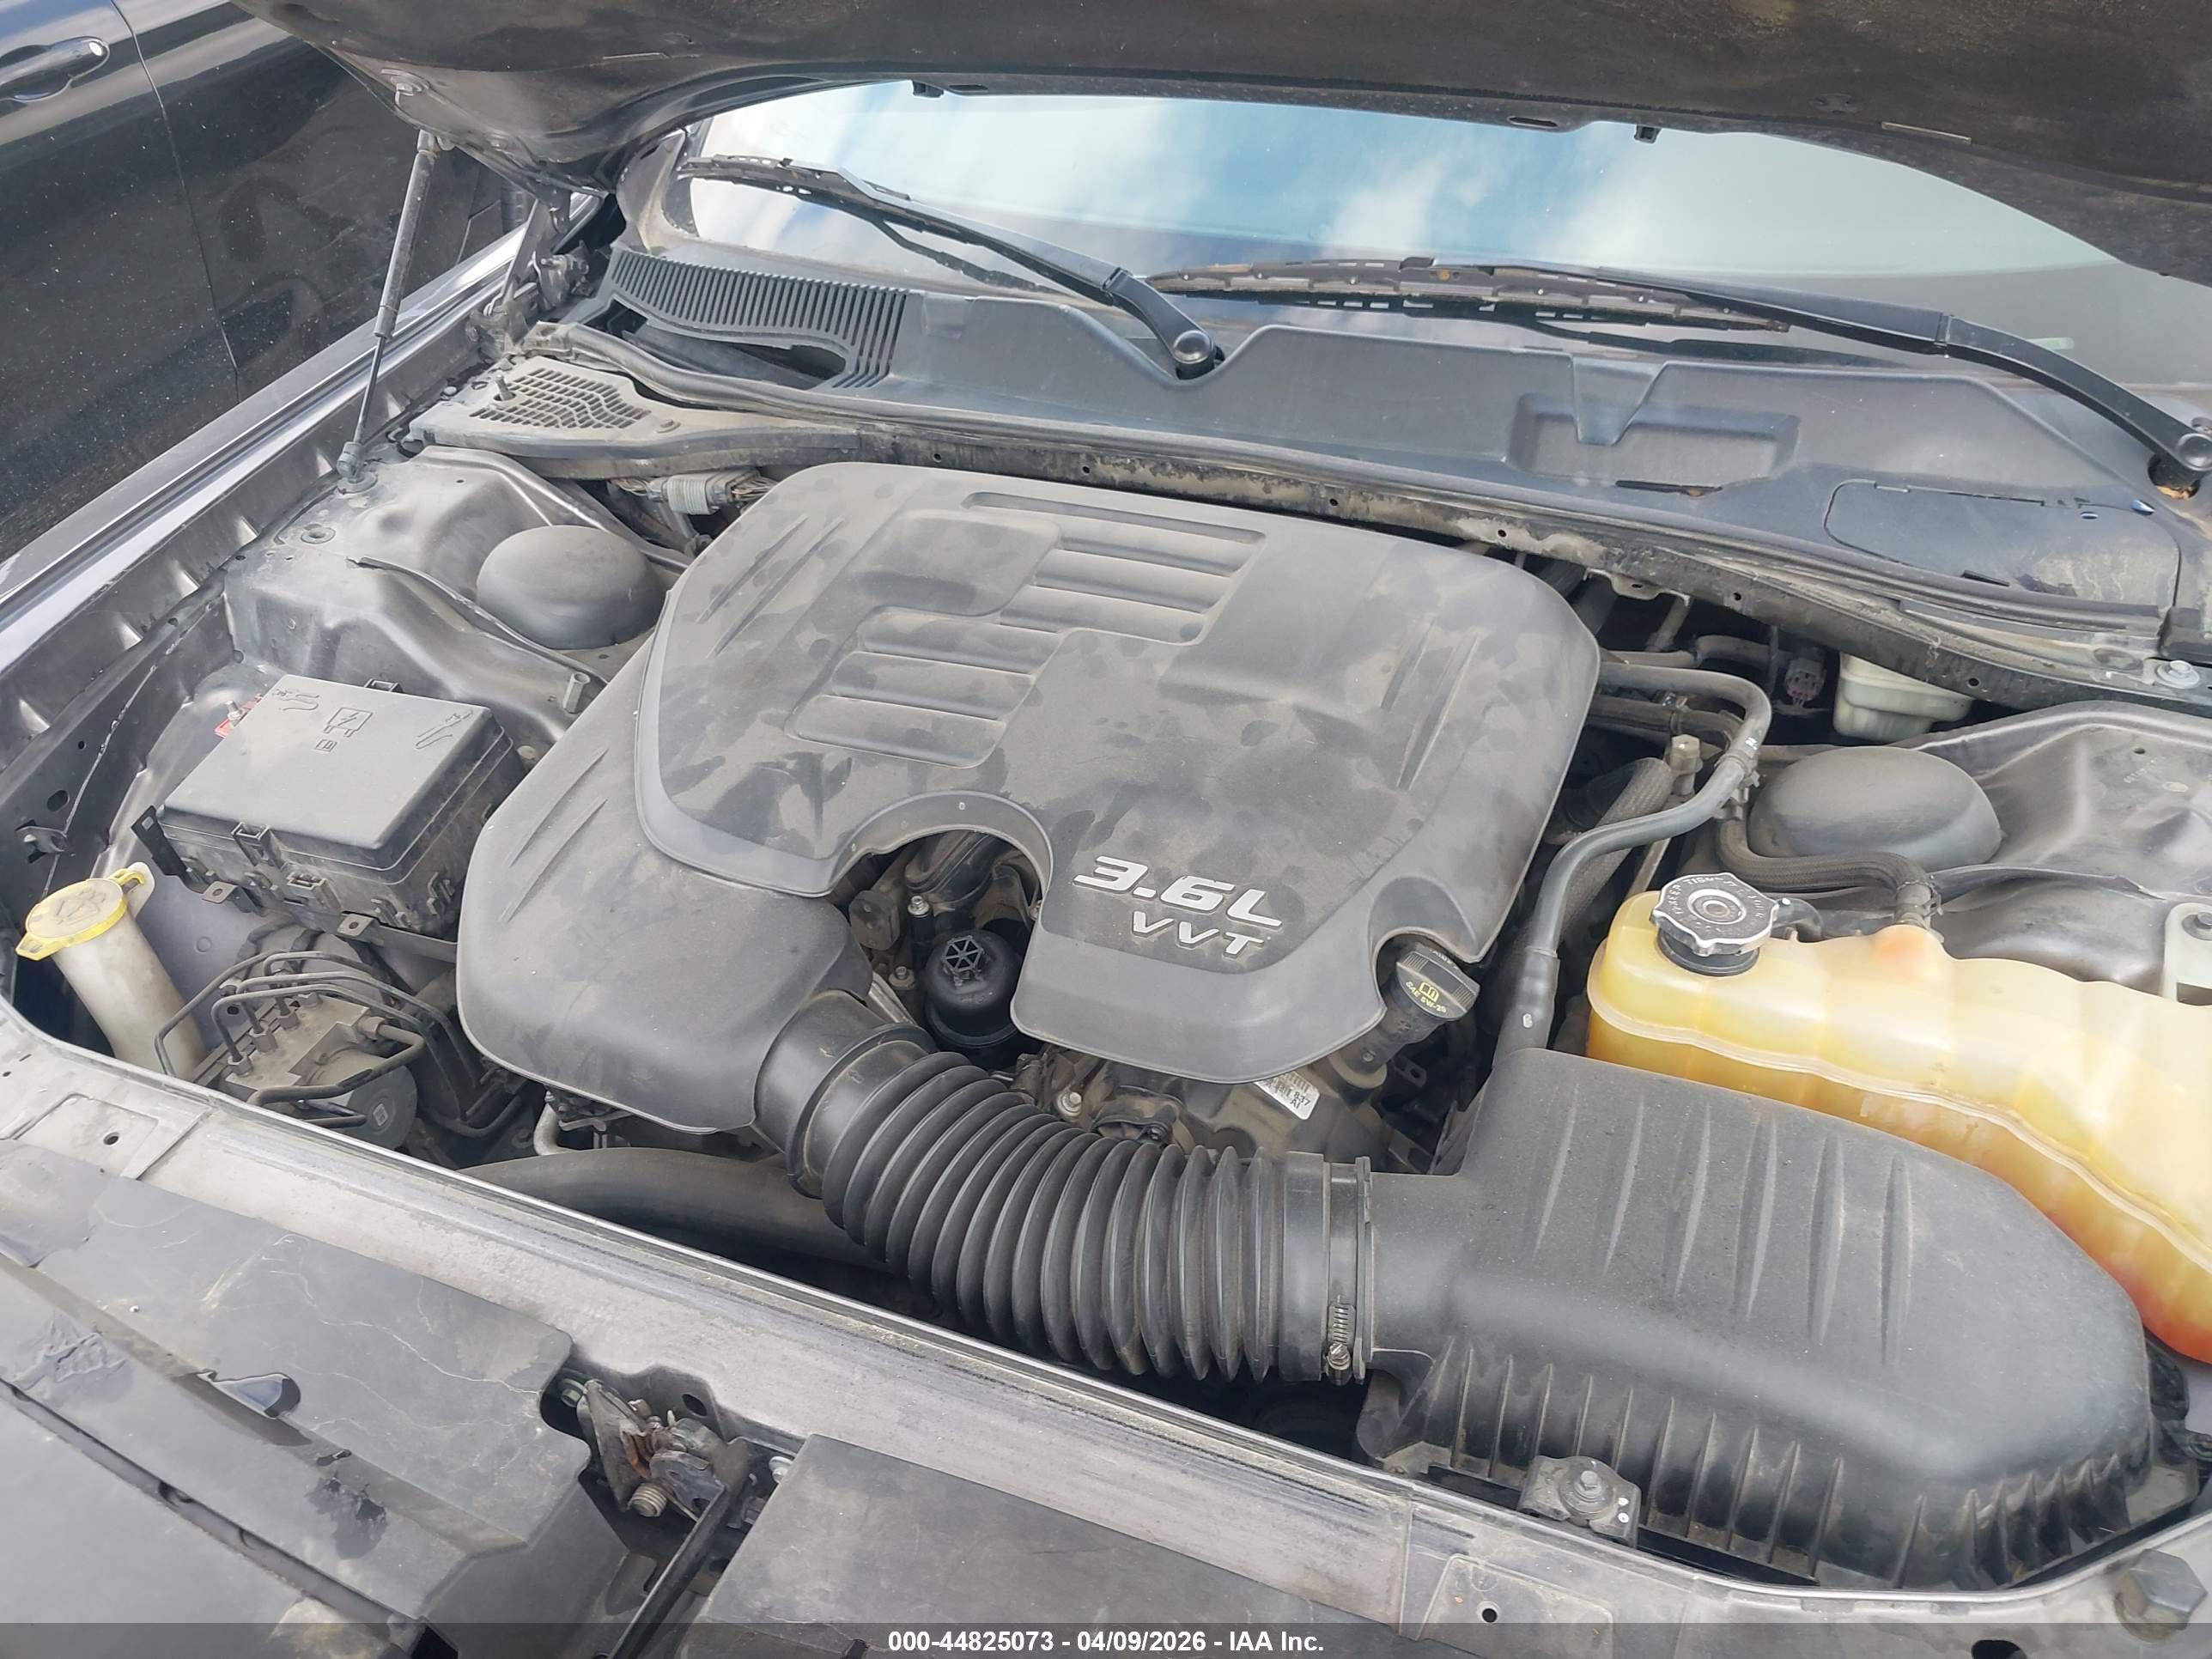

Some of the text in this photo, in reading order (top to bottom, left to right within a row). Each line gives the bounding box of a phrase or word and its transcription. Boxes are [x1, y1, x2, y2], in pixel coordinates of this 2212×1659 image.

[1073, 855, 1283, 929] 3.6L
[1132, 910, 1266, 957] VVT
[1293, 1091, 1310, 1106] 837
